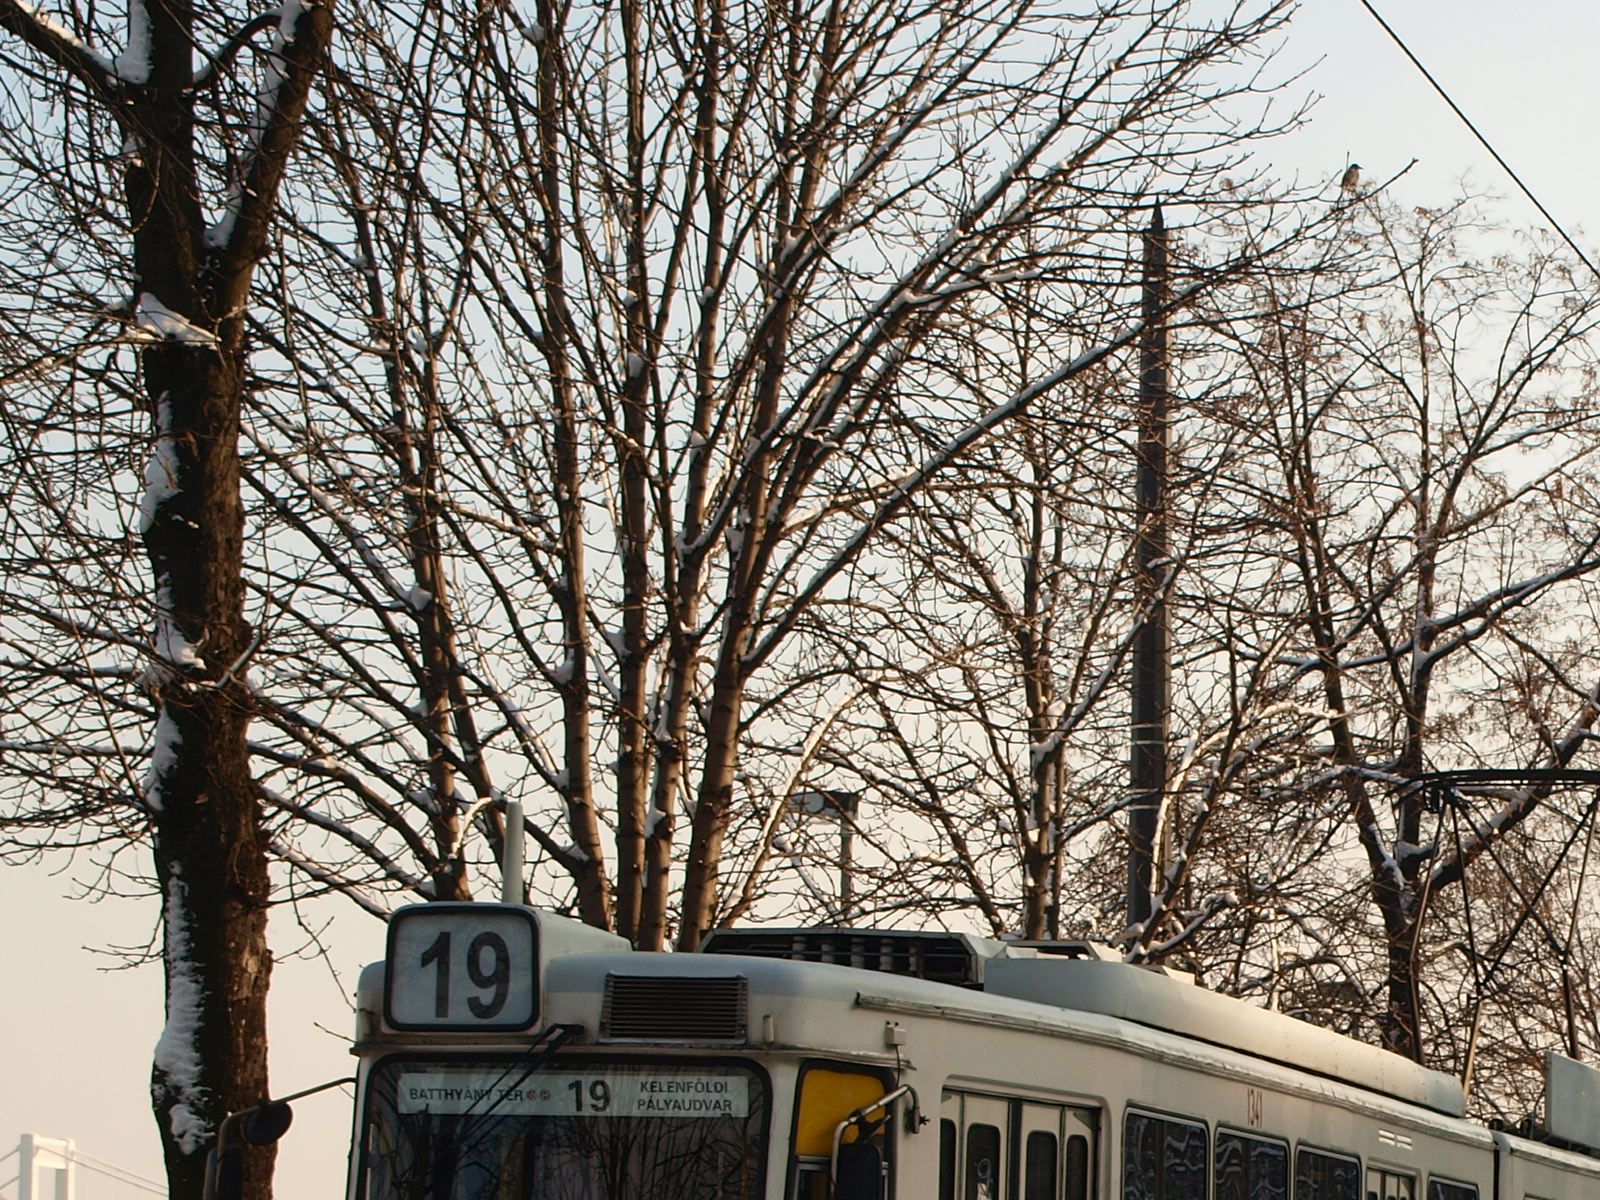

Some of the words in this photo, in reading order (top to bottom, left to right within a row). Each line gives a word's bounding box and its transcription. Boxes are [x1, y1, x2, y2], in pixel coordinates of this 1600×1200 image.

[421, 931, 510, 1020] 19
[409, 1085, 492, 1100] BATTHYÁNY
[568, 1080, 611, 1112] 19
[640, 1078, 728, 1093] KELENFÖLDI
[637, 1096, 732, 1111] PÁLYAUDVAR
[1247, 1087, 1263, 1129] 1341
